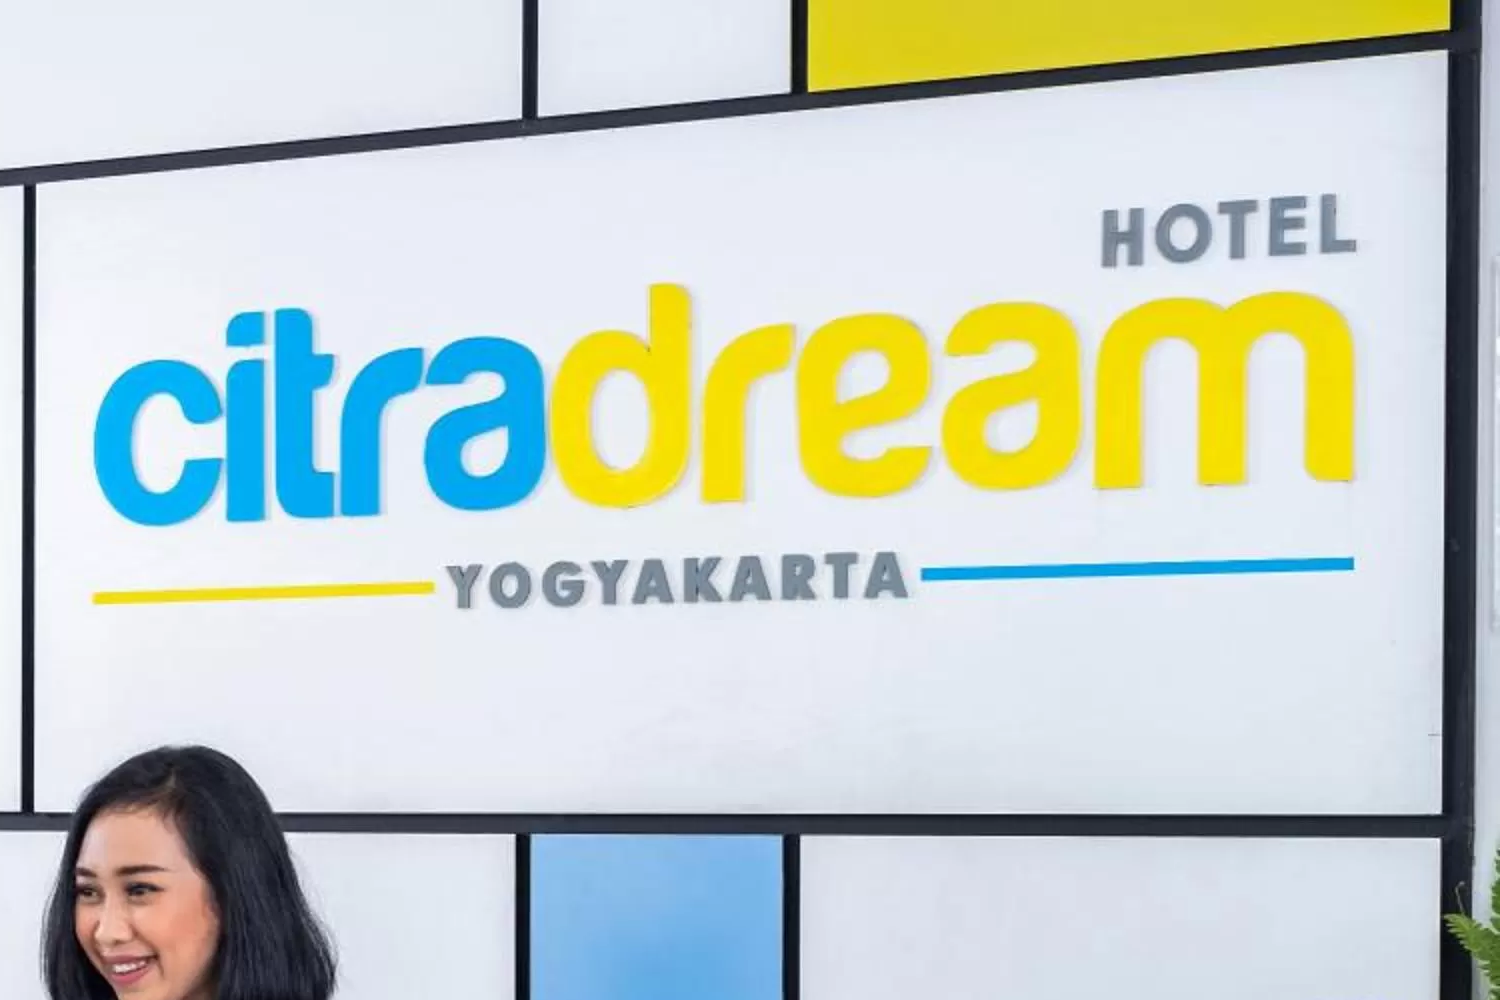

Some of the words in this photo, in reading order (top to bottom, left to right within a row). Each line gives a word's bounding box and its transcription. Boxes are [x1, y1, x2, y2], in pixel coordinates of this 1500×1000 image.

[1100, 194, 1357, 267] HOTEL
[94, 284, 1356, 526] citradream
[447, 551, 908, 609] YOGYAKARTA
